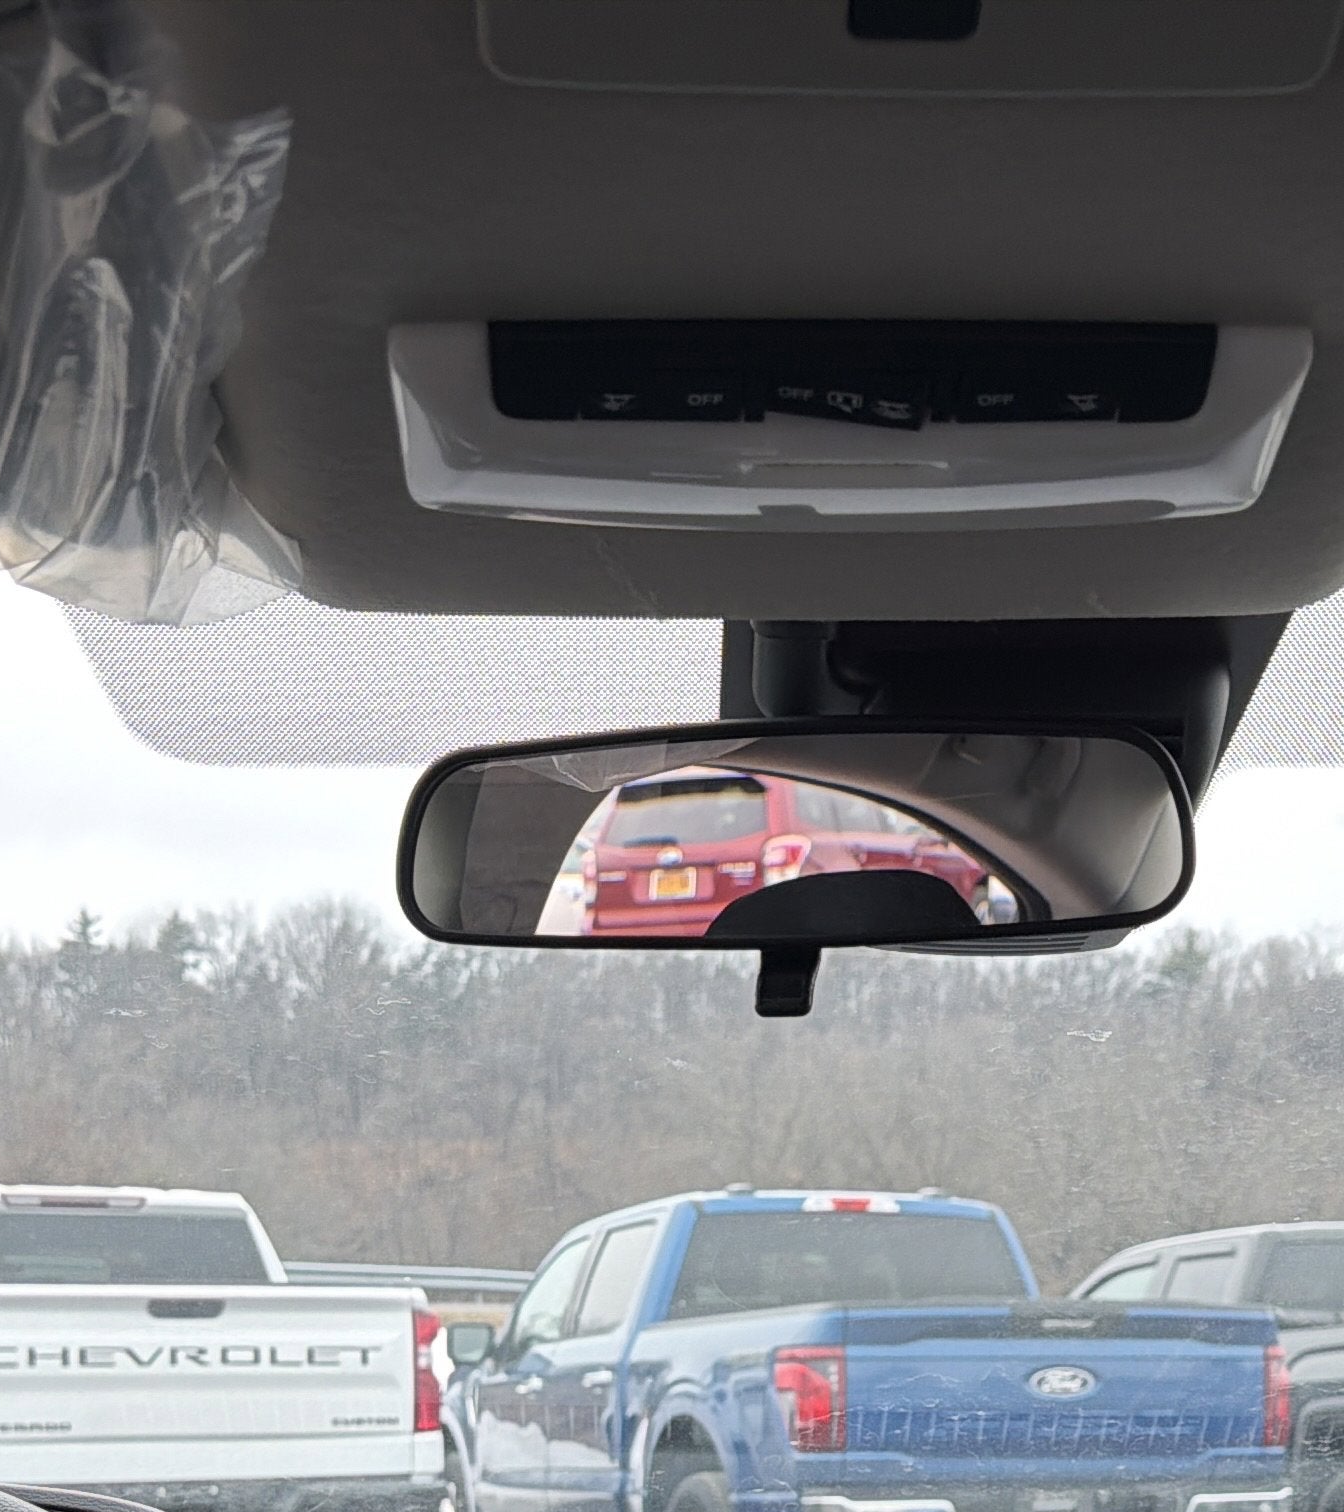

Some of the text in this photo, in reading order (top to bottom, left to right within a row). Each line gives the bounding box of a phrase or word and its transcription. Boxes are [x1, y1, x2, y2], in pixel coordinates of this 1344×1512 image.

[777, 386, 813, 401] OFF
[688, 394, 723, 406] OFF
[977, 394, 1013, 406] OFF
